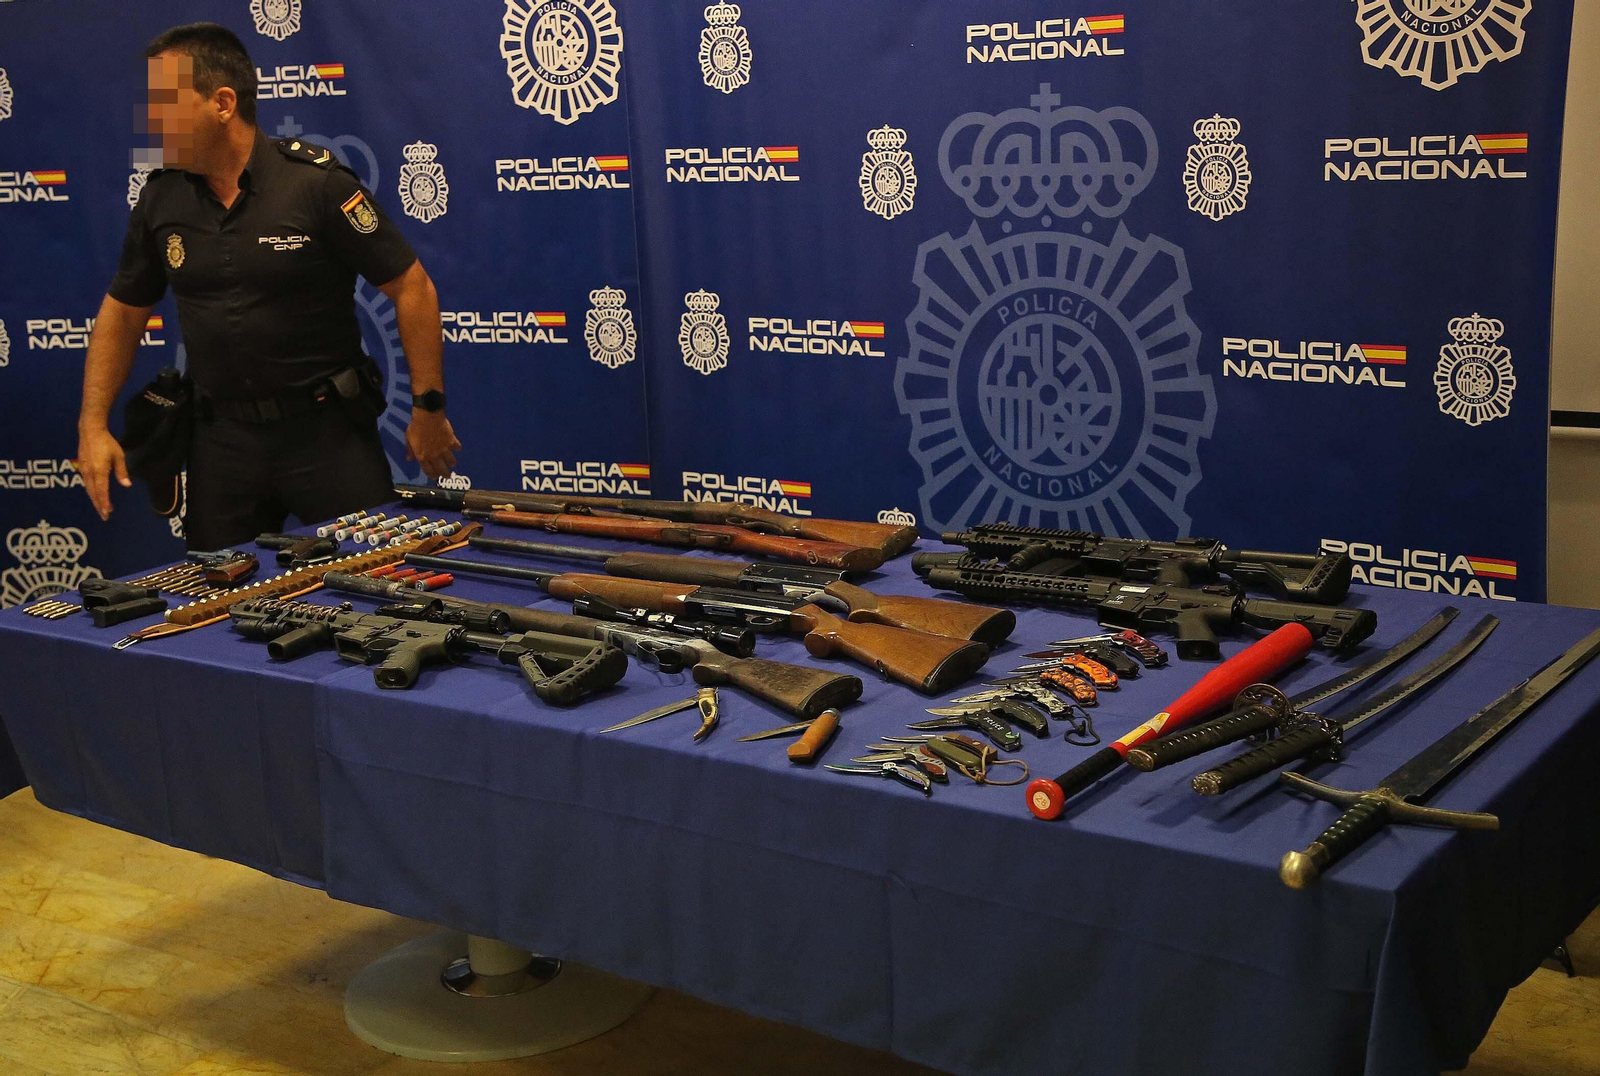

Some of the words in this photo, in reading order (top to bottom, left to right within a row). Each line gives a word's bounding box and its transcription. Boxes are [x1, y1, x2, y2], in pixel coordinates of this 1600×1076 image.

[1400, 7, 1482, 34] NACIONAL
[966, 37, 1125, 64] NACIONAL
[536, 64, 590, 84] NACIONAL
[256, 81, 347, 99] CIONAL
[666, 165, 800, 183] NACIONAL
[1324, 158, 1528, 182] NACIONAL
[497, 173, 631, 192] NACIONAL
[258, 235, 311, 244] POLICIA
[274, 243, 303, 251] CNP
[26, 317, 97, 334] POLI
[441, 328, 569, 344] NACIONAL
[749, 335, 886, 358] NACIONAL
[1222, 358, 1407, 388] NACIONAL
[983, 444, 1119, 497] NACIONAL
[521, 476, 652, 496] NACIONAL
[1350, 563, 1517, 602] ACIONAL
